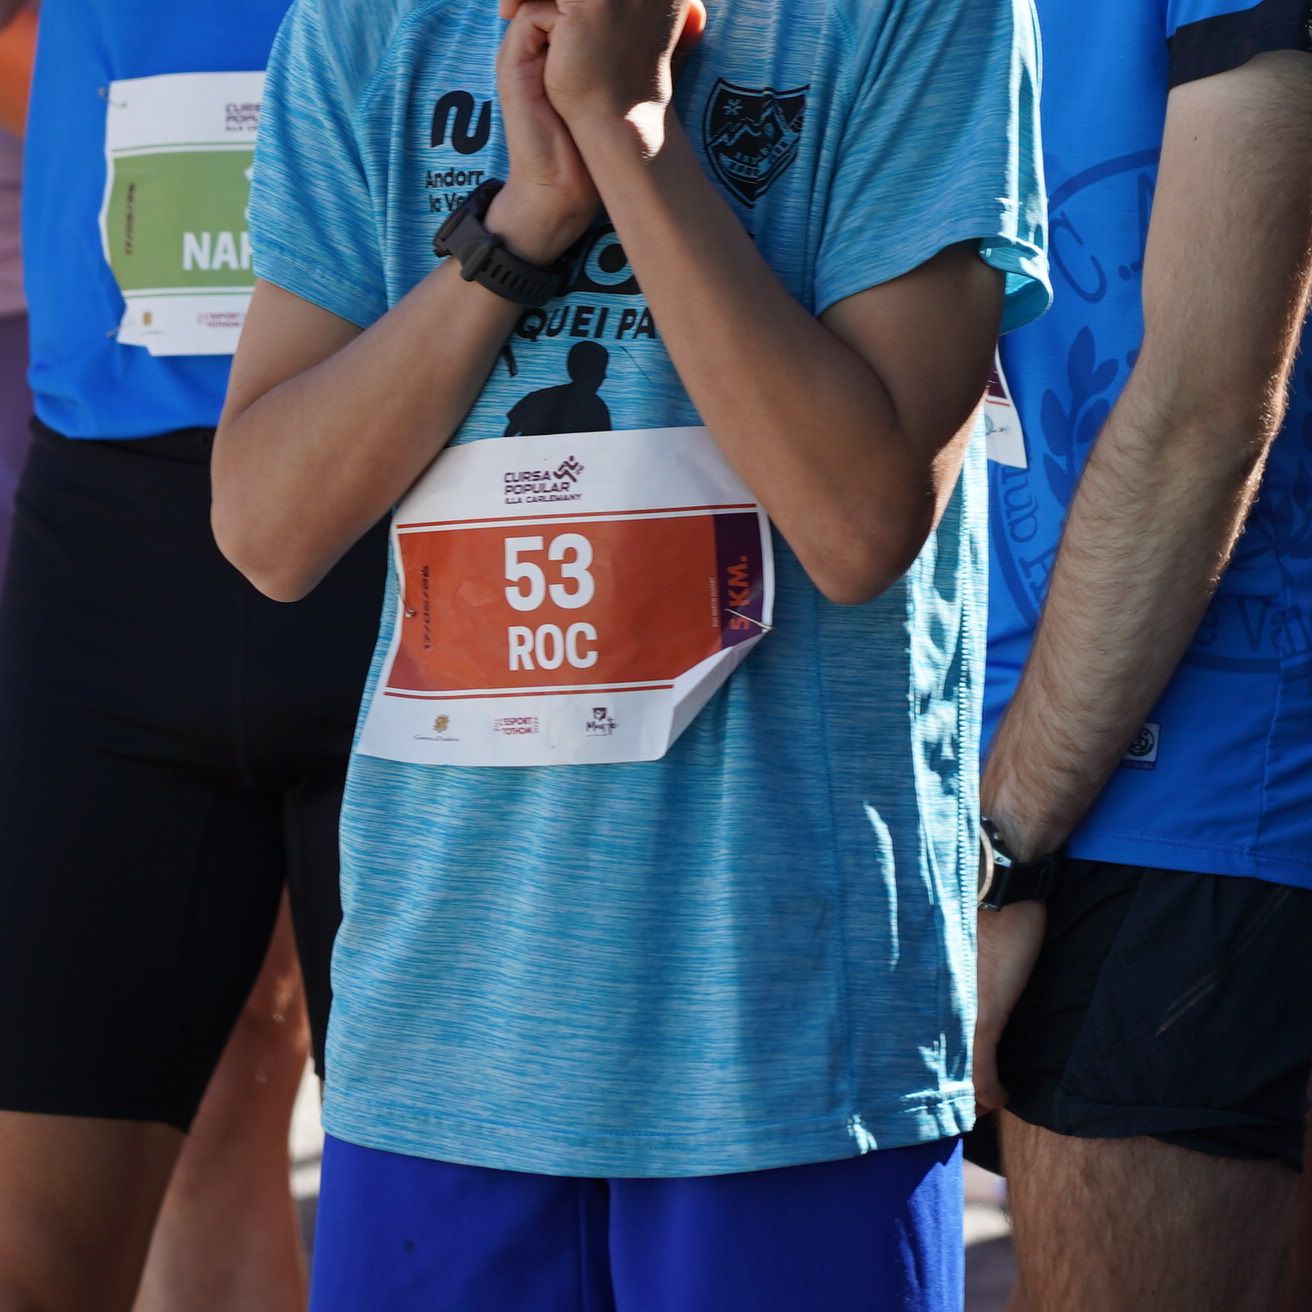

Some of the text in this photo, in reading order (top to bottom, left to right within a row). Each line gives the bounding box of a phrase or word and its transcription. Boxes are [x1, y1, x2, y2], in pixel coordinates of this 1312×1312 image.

[504, 471, 550, 483] CURSA
[504, 482, 570, 495] POPULAR
[504, 496, 522, 504] ILLA
[503, 532, 594, 612] 53
[726, 554, 752, 607] KM.
[507, 622, 599, 672] ROC
